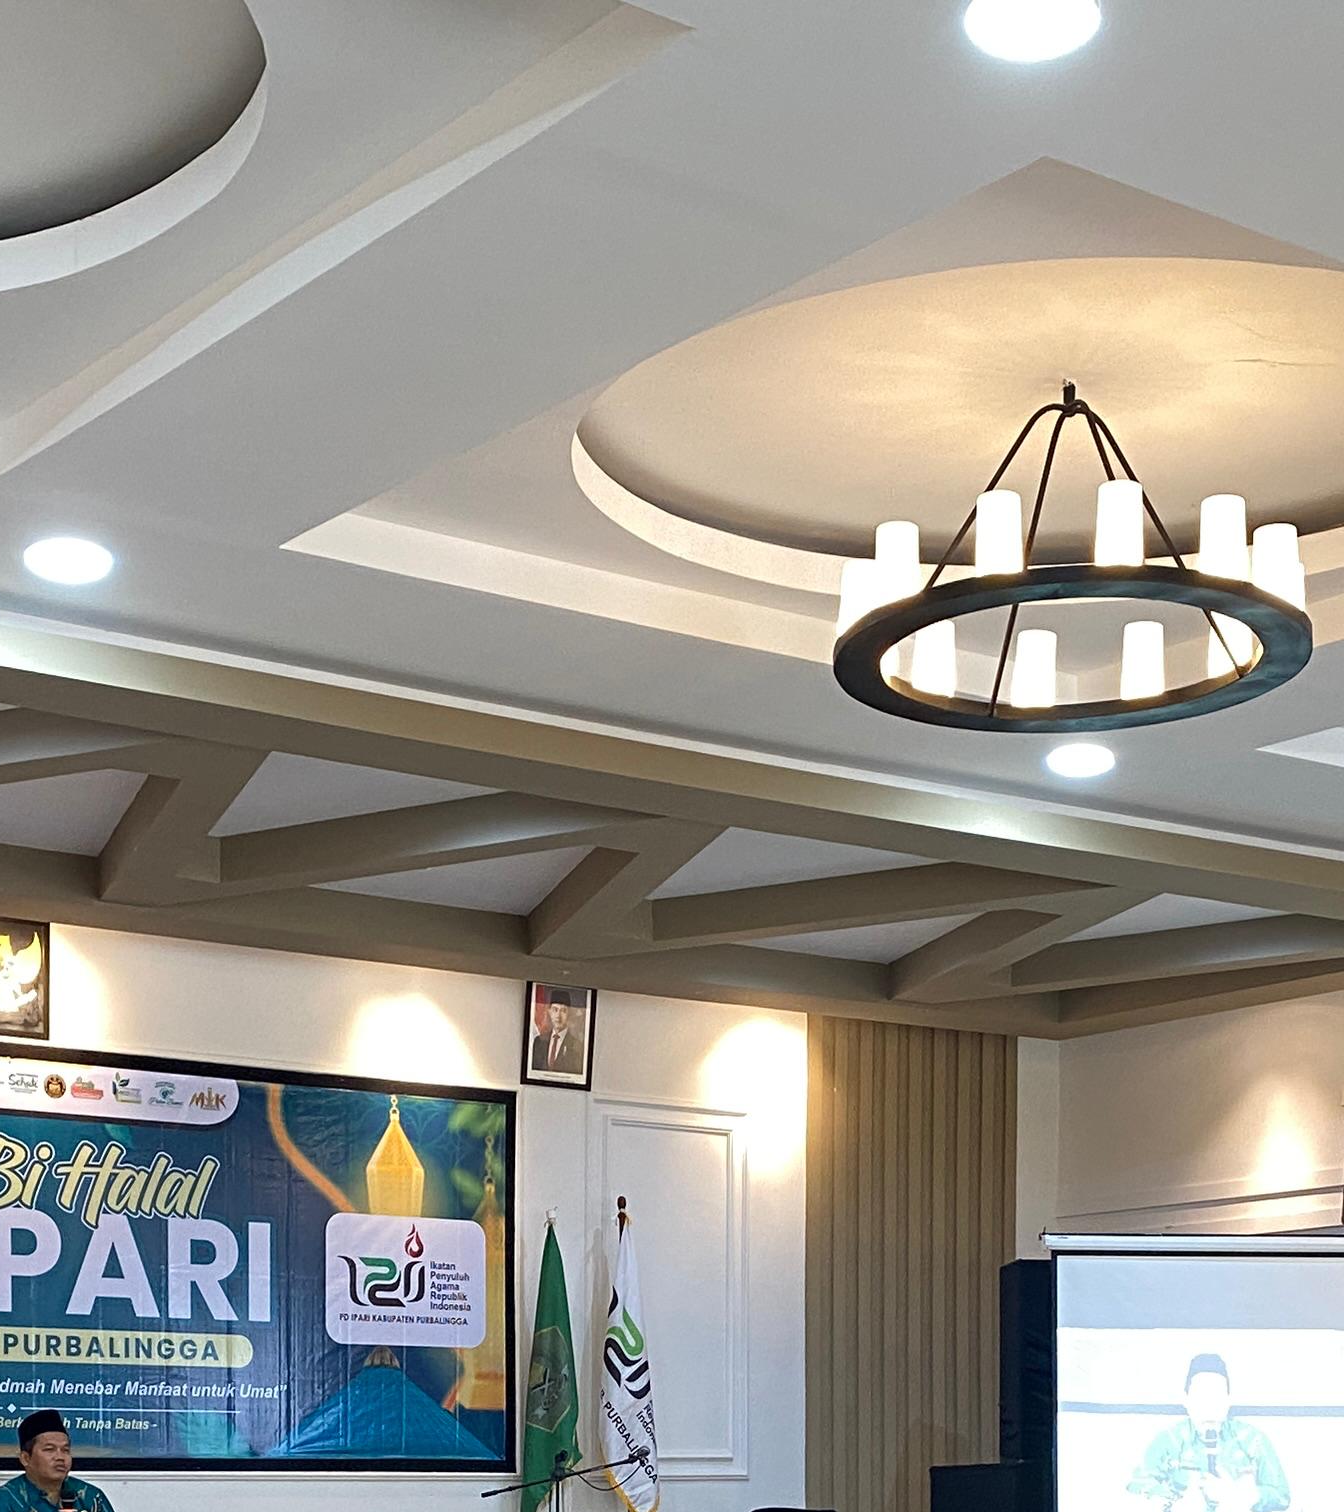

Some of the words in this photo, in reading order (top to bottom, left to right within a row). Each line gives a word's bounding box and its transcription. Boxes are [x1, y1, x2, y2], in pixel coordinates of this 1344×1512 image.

[53, 1141, 220, 1229] Halal
[430, 1261, 456, 1271] Ikatan
[430, 1271, 470, 1282] Penyuluh
[430, 1282, 460, 1292] Agama
[430, 1291, 468, 1303] Republik
[430, 1302, 471, 1311] Indonesia
[351, 1314, 371, 1322] IPARI
[372, 1314, 415, 1324] KABUPATEN
[416, 1316, 469, 1326] PURBALINGGA
[3, 1333, 221, 1361] PURBALINGGA
[50, 1379, 120, 1396] Menebar
[125, 1381, 189, 1398] Manfaat
[191, 1383, 236, 1398] untuk
[74, 1417, 112, 1431] Tanpa
[115, 1418, 149, 1430] Batas
[603, 1401, 658, 1484] PURBALIGGA
